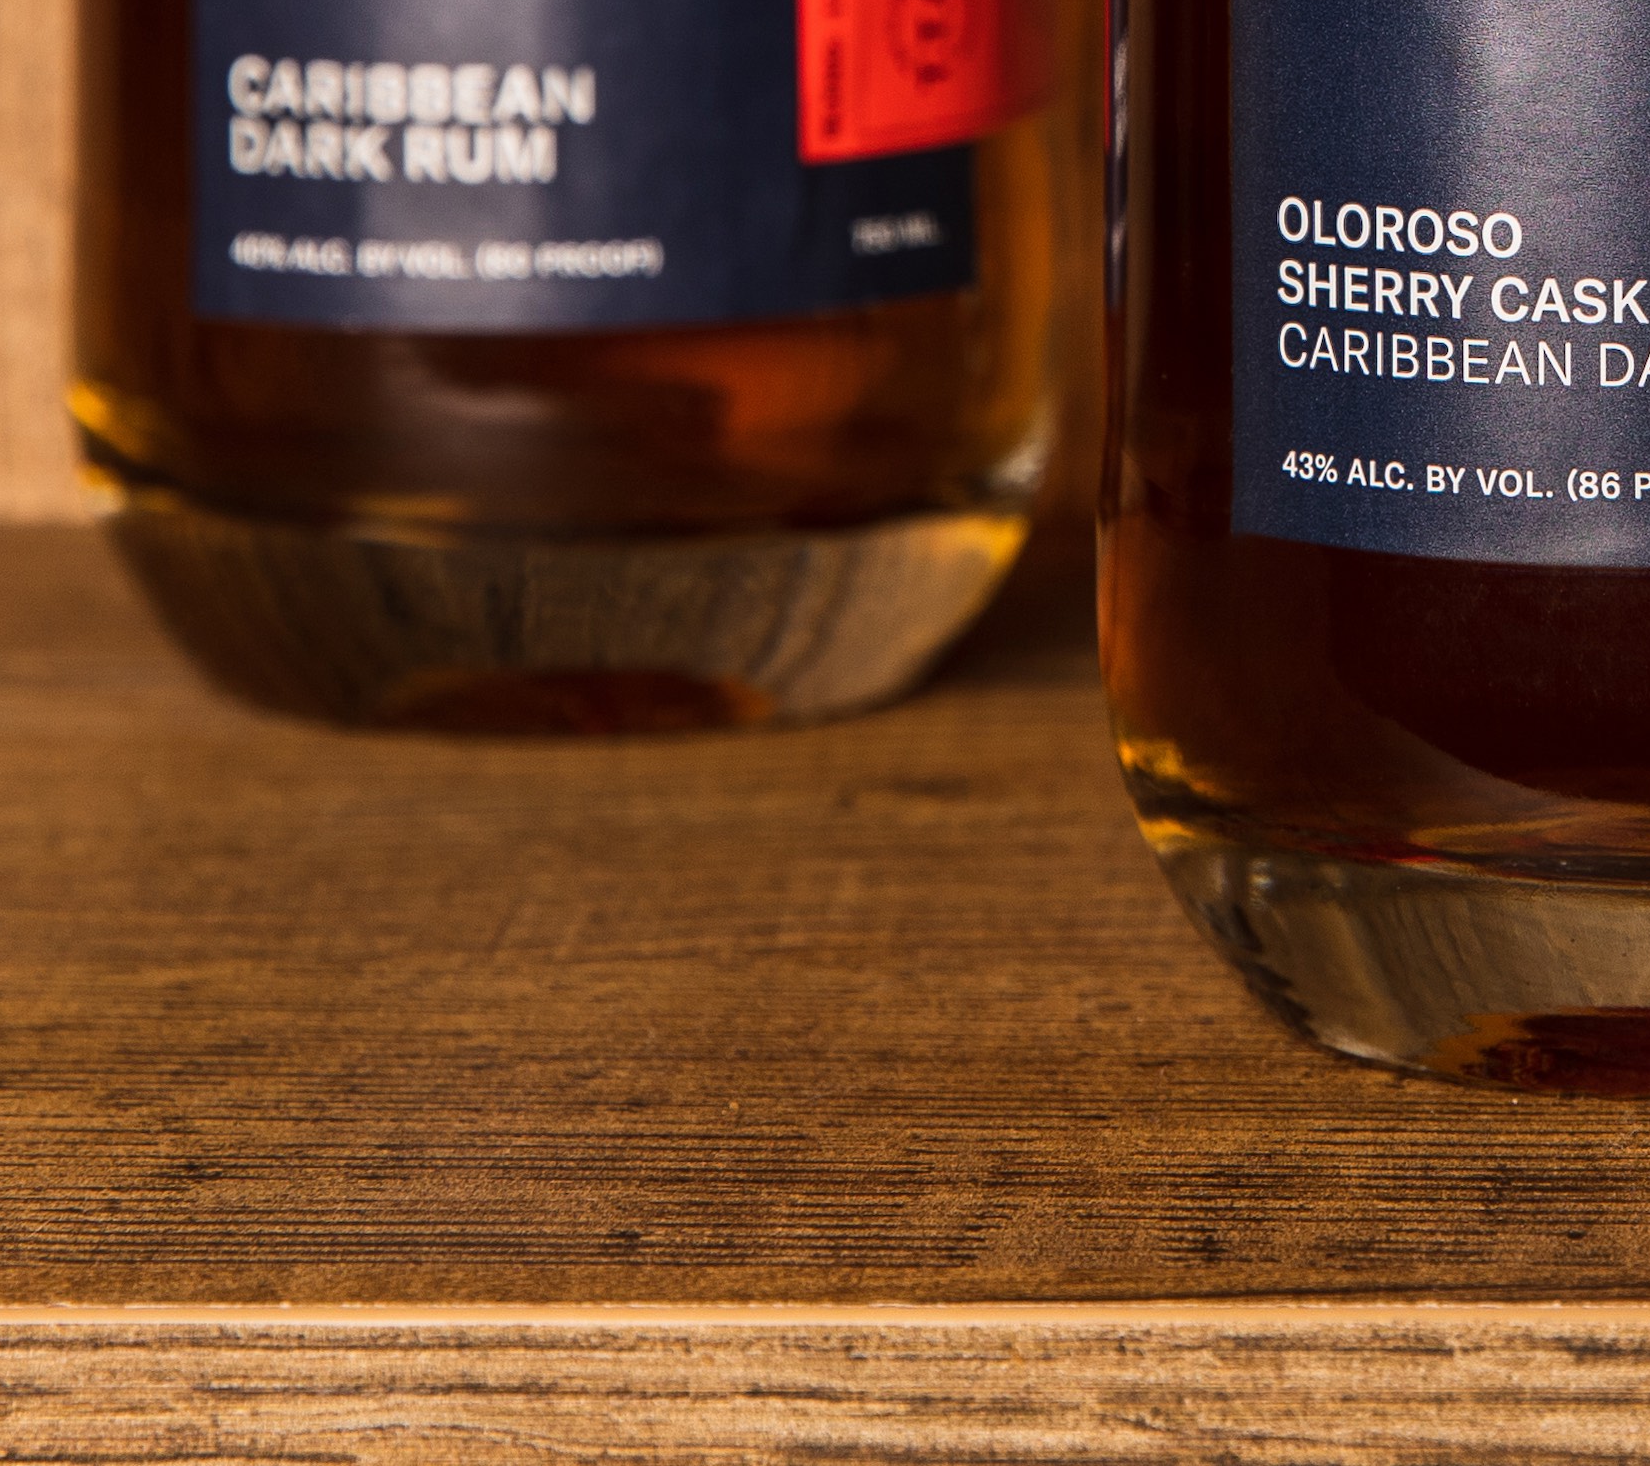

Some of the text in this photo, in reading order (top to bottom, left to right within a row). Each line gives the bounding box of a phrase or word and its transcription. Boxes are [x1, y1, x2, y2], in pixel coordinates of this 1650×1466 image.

[228, 54, 596, 125] CARIBBEAN
[229, 115, 557, 184] DARK RUM
[1277, 197, 1522, 258] OLOROSO
[1277, 259, 1473, 318] SHERRY
[1490, 276, 1648, 324] CASK
[1278, 322, 1572, 387] CARIBBEAN
[1282, 450, 1338, 483] 43%
[1347, 458, 1414, 491] ALC.
[1426, 465, 1465, 494] BY
[1476, 469, 1553, 499] VOL.
[1567, 468, 1621, 503] (86
